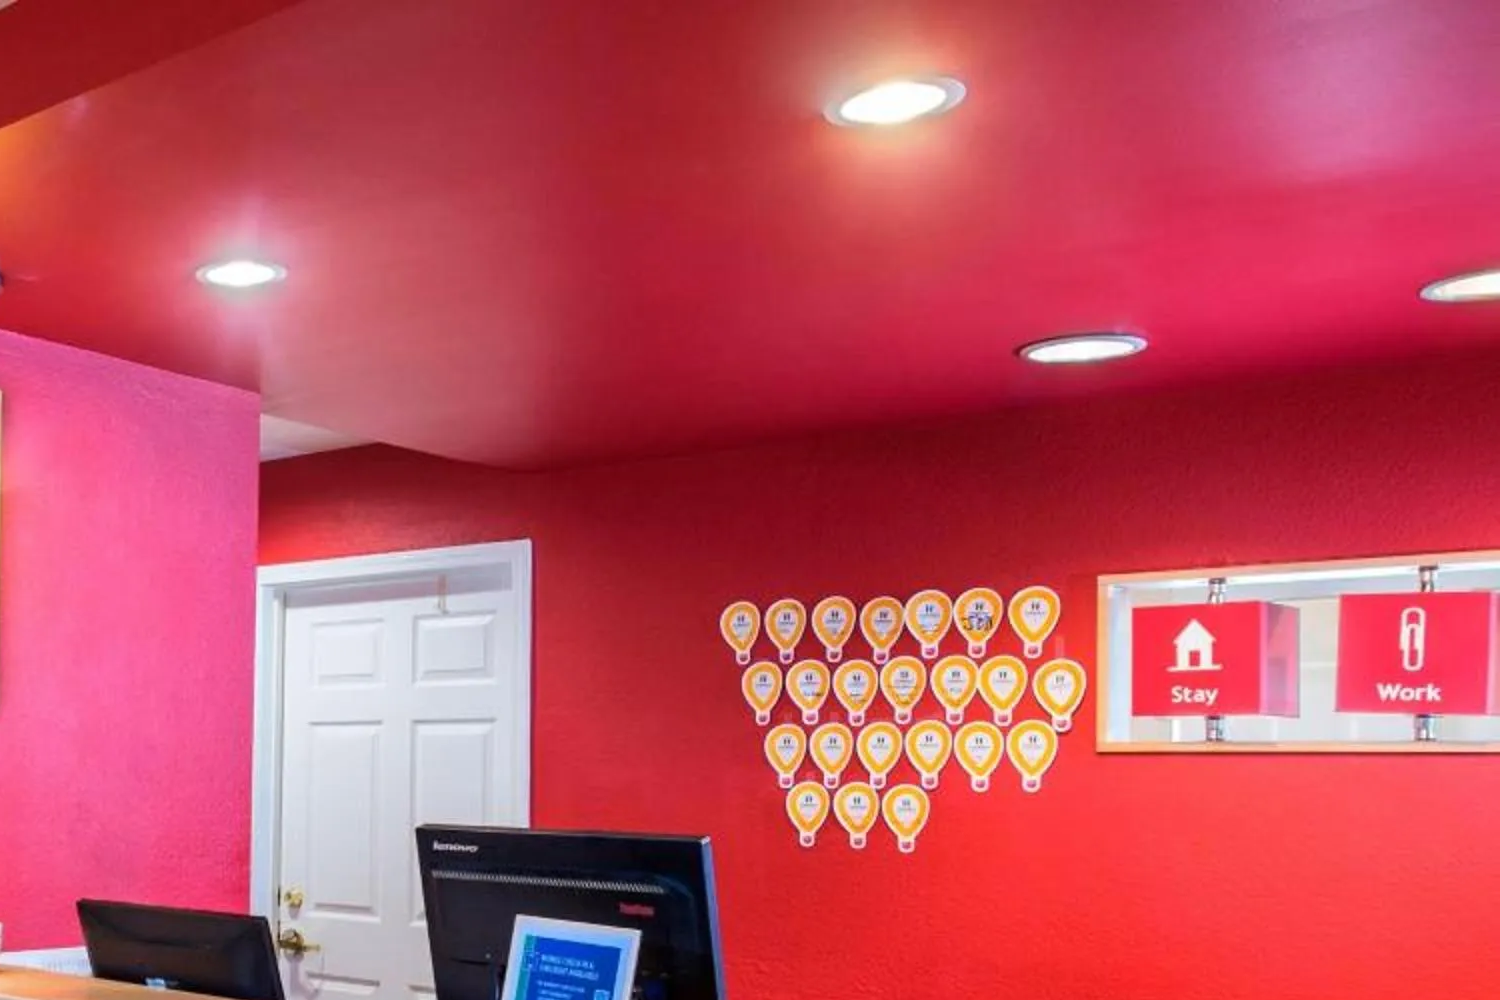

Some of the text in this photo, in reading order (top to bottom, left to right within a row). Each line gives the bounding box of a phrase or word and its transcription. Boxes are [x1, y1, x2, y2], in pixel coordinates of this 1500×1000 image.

[1171, 685, 1218, 704] Stay
[1377, 683, 1442, 701] Work
[432, 839, 480, 853] lenovo
